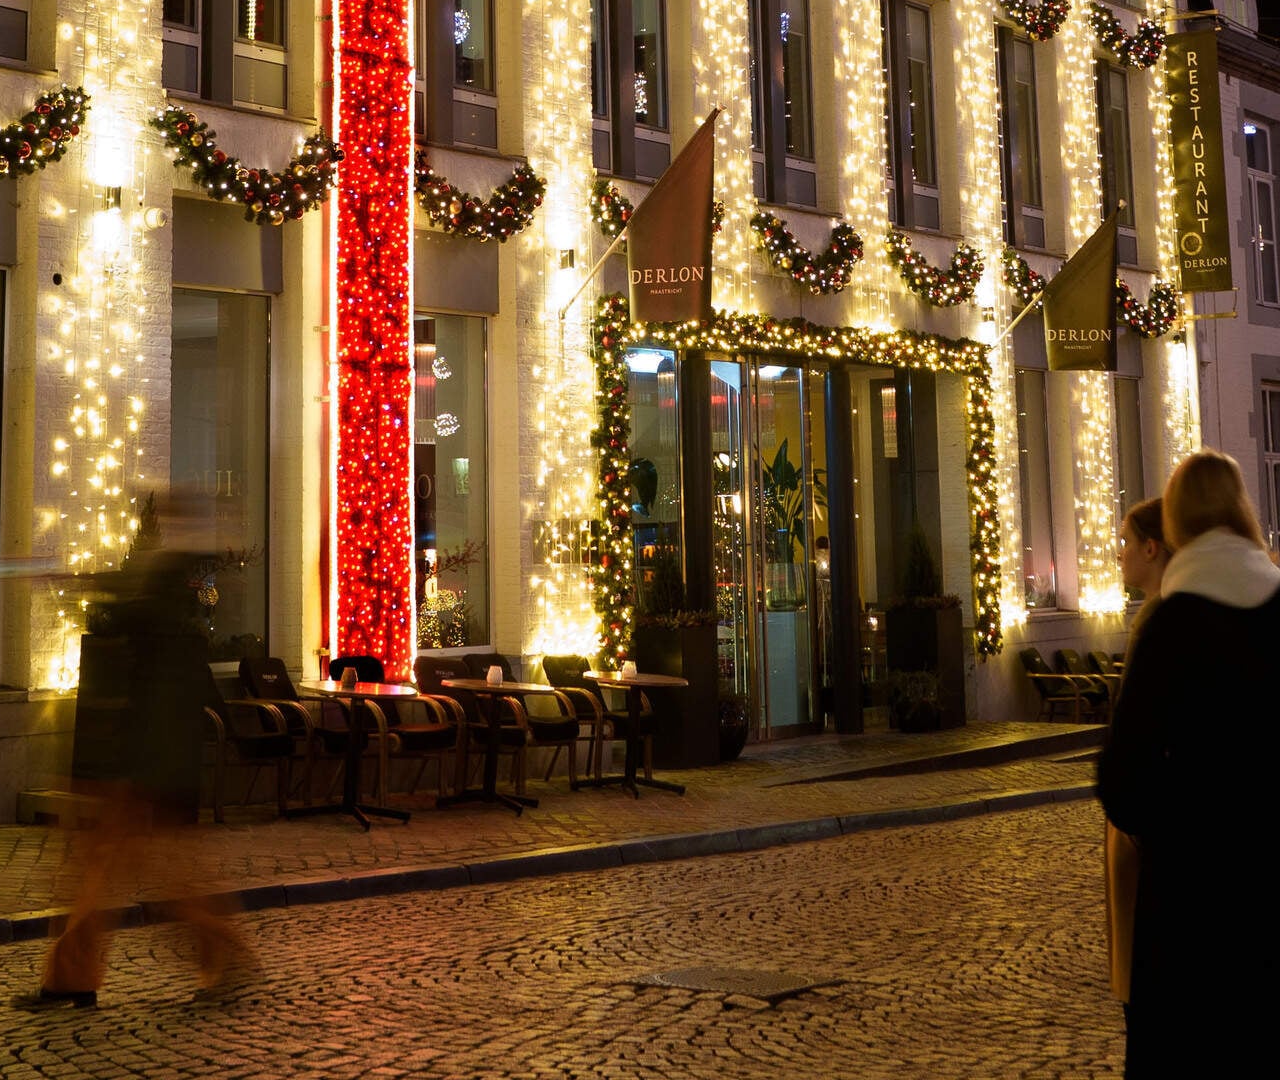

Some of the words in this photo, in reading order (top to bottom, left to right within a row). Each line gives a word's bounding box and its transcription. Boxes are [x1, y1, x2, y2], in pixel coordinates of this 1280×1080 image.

[1186, 51, 1210, 234] RESTAURANT
[1184, 257, 1228, 269] DERLON
[631, 266, 705, 285] DERLON
[1047, 328, 1112, 342] DERLON
